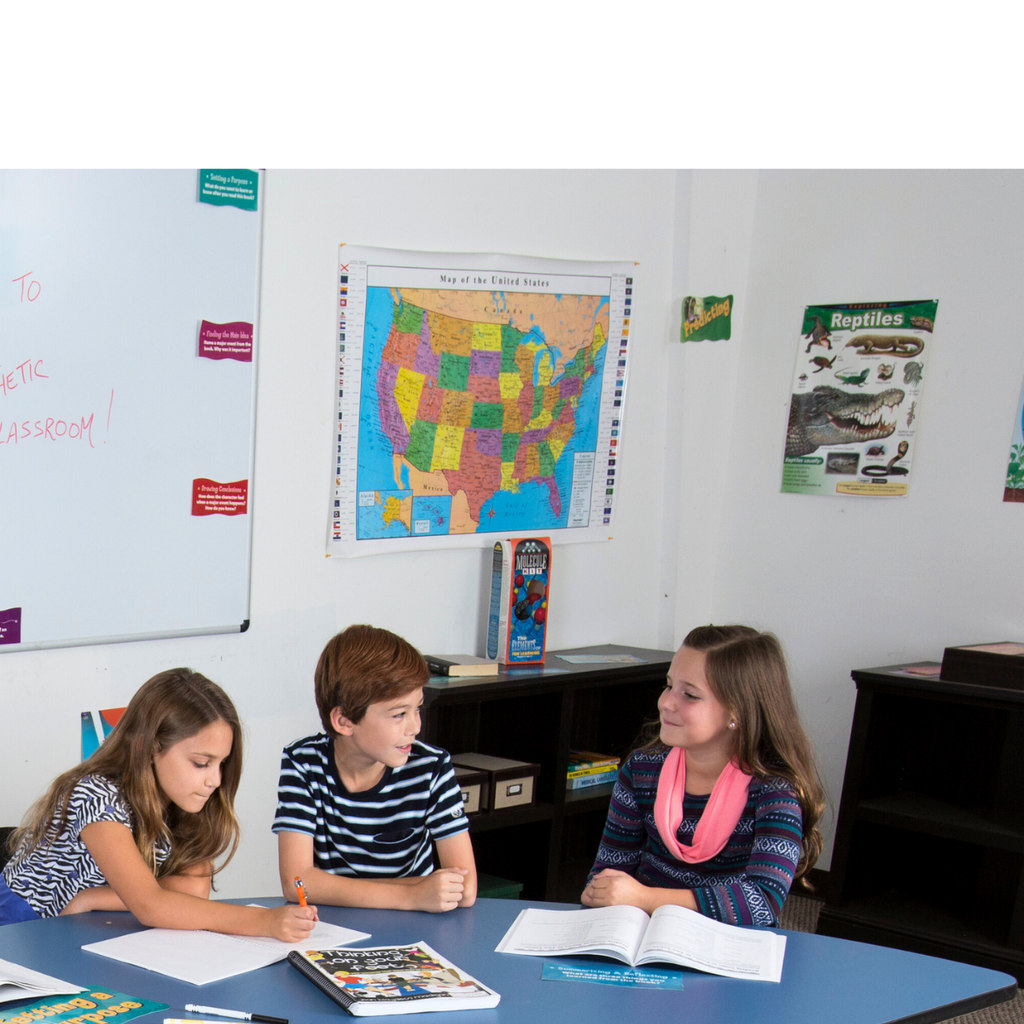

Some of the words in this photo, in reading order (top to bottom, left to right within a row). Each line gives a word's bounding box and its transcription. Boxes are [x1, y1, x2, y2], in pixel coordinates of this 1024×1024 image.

[12, 271, 41, 302] TO
[440, 275, 456, 284] Map
[474, 275, 487, 284] the
[491, 275, 519, 286] United
[524, 278, 549, 287] States
[484, 306, 523, 315] Canada
[684, 299, 730, 338] Predicting
[831, 312, 903, 331] Reptiles
[516, 554, 547, 570] MOLECULE
[558, 966, 611, 975] Summarizing
